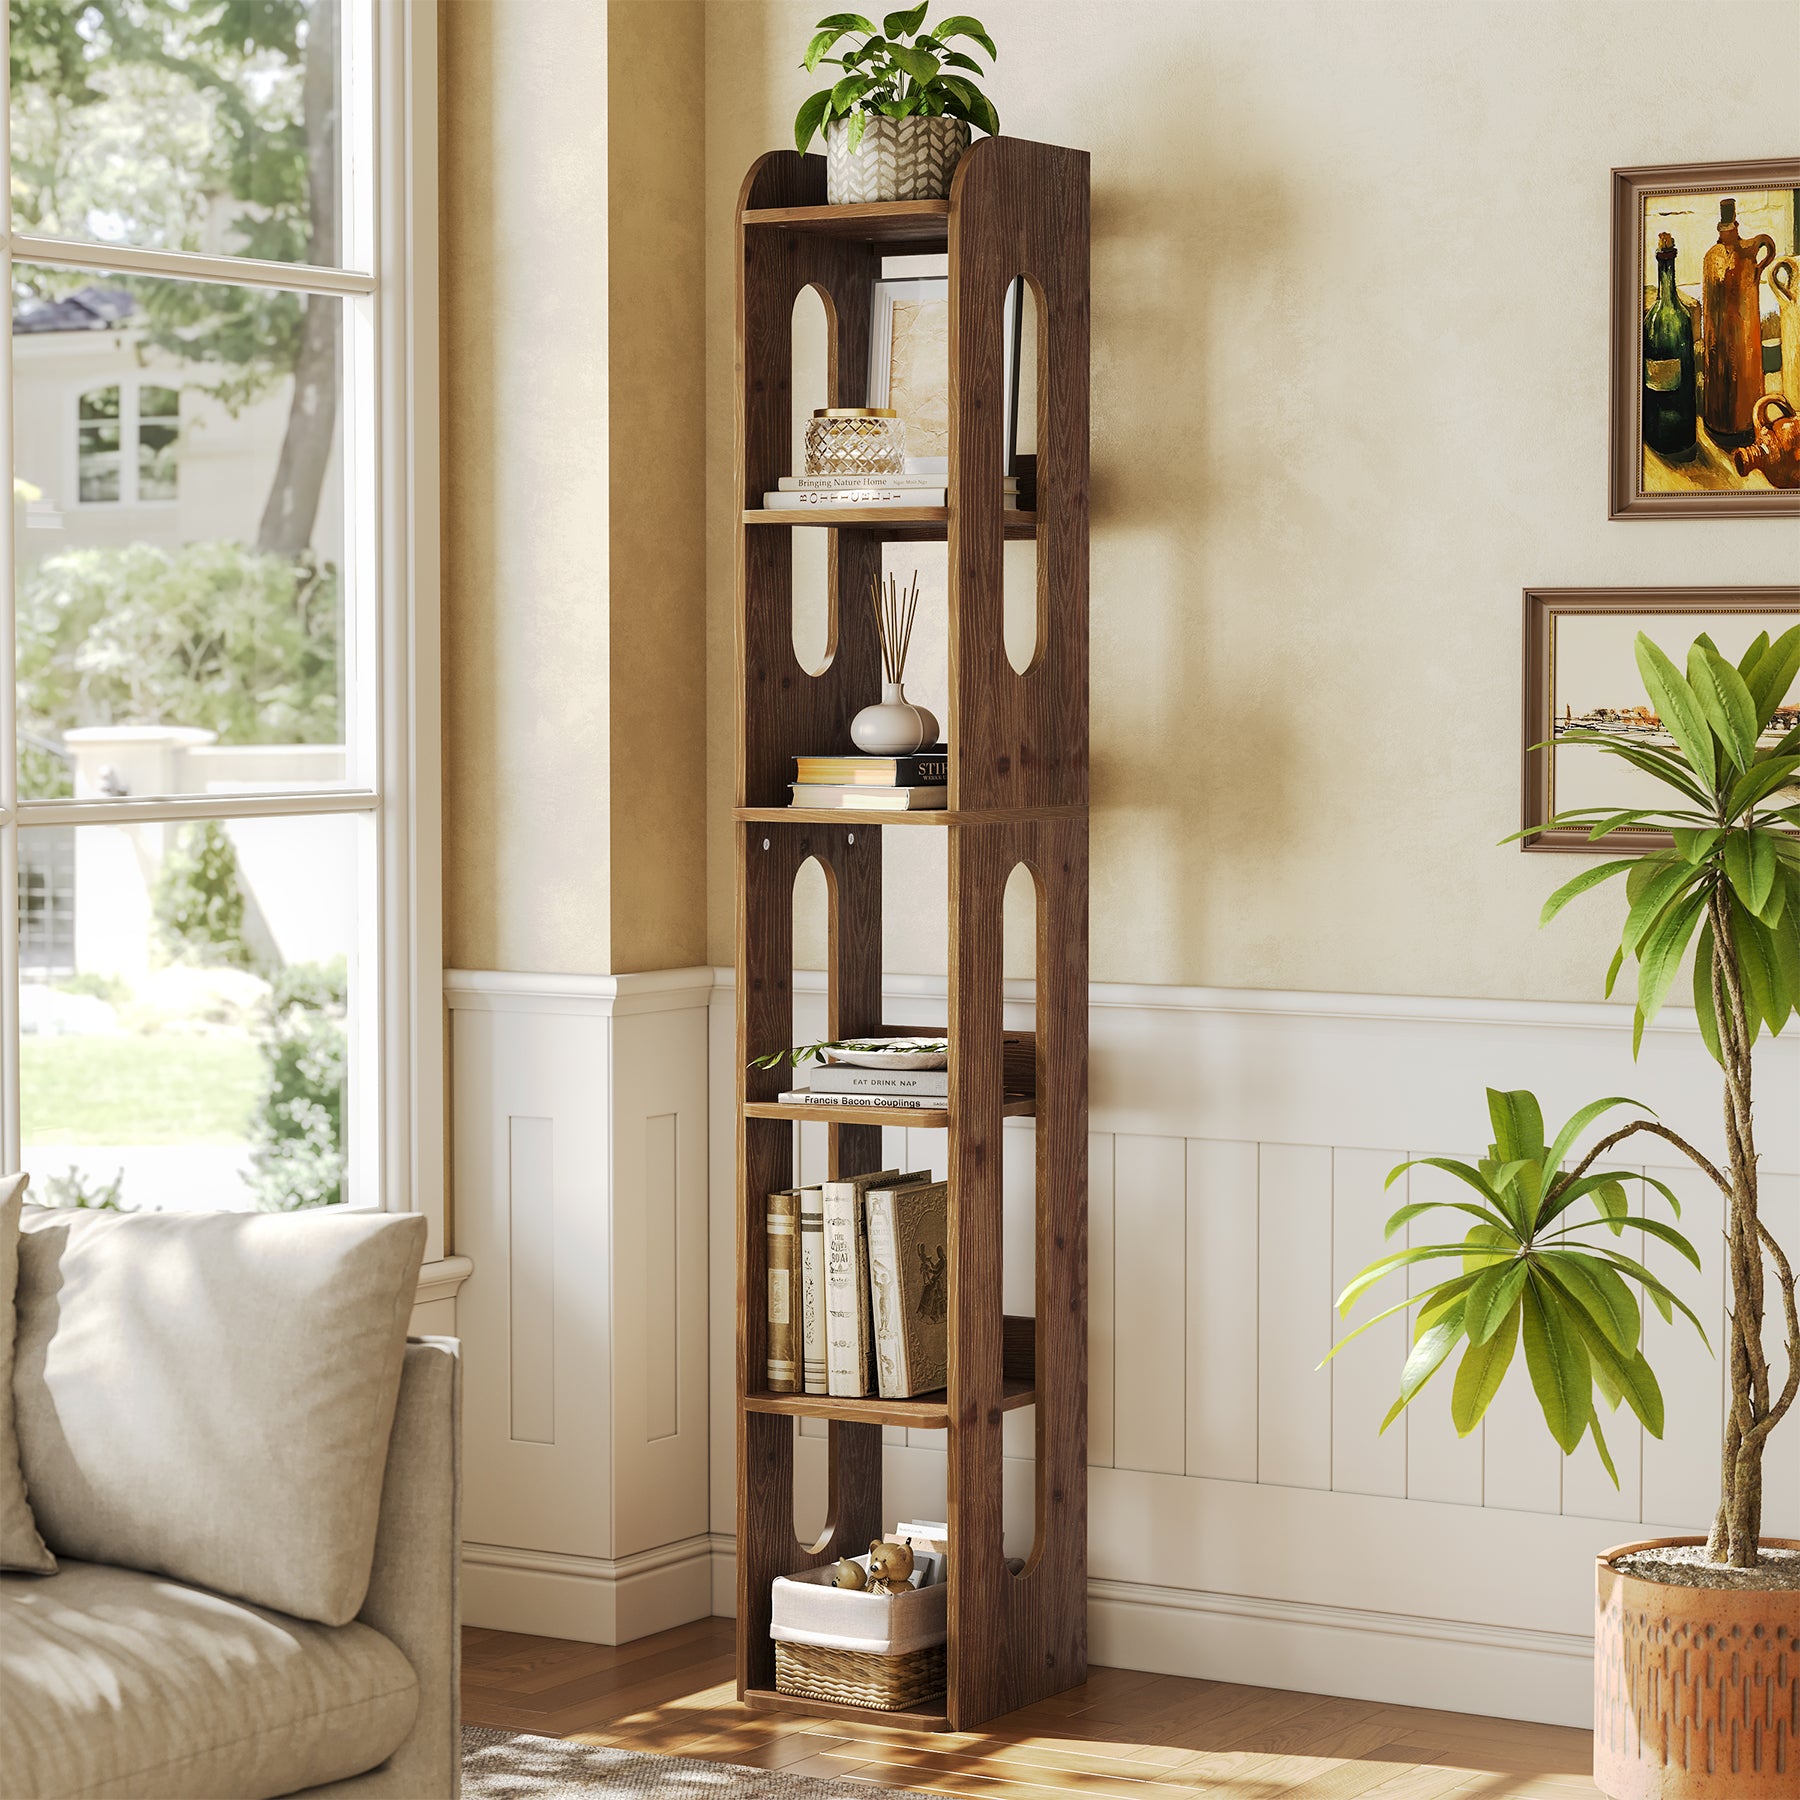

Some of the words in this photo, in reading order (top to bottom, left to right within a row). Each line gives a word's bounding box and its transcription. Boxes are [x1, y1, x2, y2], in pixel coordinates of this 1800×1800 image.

[798, 479, 832, 489] Bringing
[833, 478, 862, 487] Nature
[863, 478, 887, 486] Home
[799, 492, 901, 504] BOTTICELLI
[871, 1079, 897, 1087] DRINK
[804, 1095, 838, 1104] Francis
[841, 1097, 871, 1106] Bacon
[873, 1098, 921, 1108] Couplings
